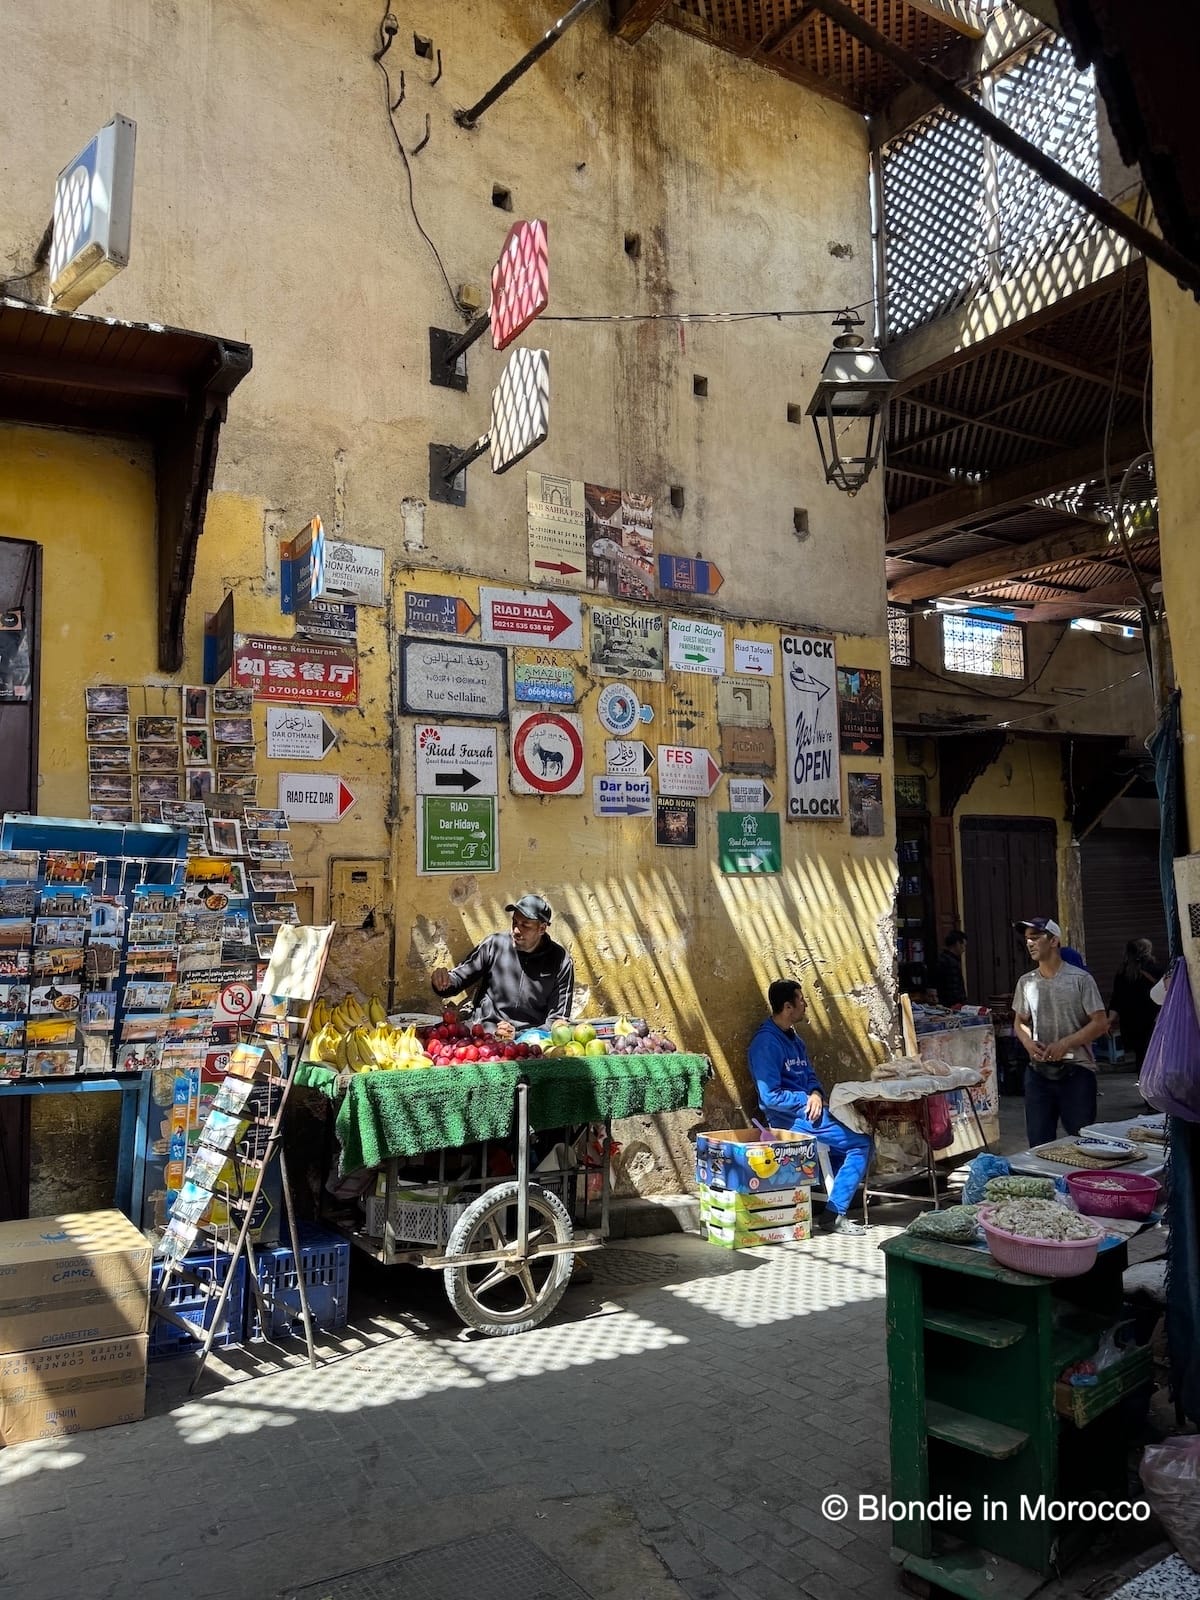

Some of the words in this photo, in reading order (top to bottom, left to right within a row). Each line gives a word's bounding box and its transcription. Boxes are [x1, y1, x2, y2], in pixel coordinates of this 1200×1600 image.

[545, 504, 569, 517] SAHRA
[570, 510, 585, 519] FES
[331, 572, 352, 581] HOSTEL
[345, 564, 380, 577] KAWTAR
[408, 594, 430, 608] Dar
[409, 608, 439, 622] Iman
[494, 604, 520, 616] RIAD
[524, 608, 554, 619] HALA
[494, 620, 514, 628] 00212
[594, 612, 620, 627] Riad
[671, 622, 692, 633] Riad
[694, 625, 722, 638] Ridaya
[679, 643, 704, 652] PANORAMIC
[704, 646, 716, 654] VIEW
[698, 638, 712, 646] HOUSE
[735, 644, 748, 652] Riad
[784, 637, 833, 659] CLOCK
[252, 642, 287, 652] Chinese
[290, 645, 338, 656] Restaurant
[467, 656, 489, 671] زنقة
[536, 656, 558, 666] DAR
[237, 657, 353, 684] 如家餐厅
[524, 679, 569, 690] GUESTHOUSE
[269, 686, 342, 698] 0700491766
[426, 689, 444, 700] Rue
[447, 690, 487, 704] Sellaline
[288, 732, 320, 740] OTHMANE
[816, 731, 832, 744] We're
[426, 743, 456, 757] Riad
[460, 744, 493, 758] Farah
[666, 750, 693, 764] FES
[426, 758, 440, 766] Guest
[794, 749, 832, 785] OPEN
[600, 780, 622, 792] Dar
[626, 780, 649, 794] borj
[731, 786, 740, 794] RIAD
[286, 791, 304, 803] RIAD
[305, 791, 318, 804] FEZ
[319, 792, 334, 804] DAR
[600, 795, 624, 803] Guest
[626, 795, 650, 803] house
[658, 798, 674, 806] RIAD
[675, 799, 696, 808] NOHA
[450, 802, 469, 812] RIAD
[790, 797, 840, 816] CLOCK
[440, 819, 452, 830] Dar
[454, 819, 480, 832] Hidaya
[728, 838, 741, 847] Riad
[229, 992, 244, 1006] 18
[218, 1056, 227, 1065] 18
[768, 1232, 786, 1241] Maroc
[52, 1268, 96, 1282] CAMEL
[42, 1328, 99, 1343] CIGARETTES
[91, 1343, 130, 1355] FILTER
[7, 1351, 83, 1368] CIGARETTES
[93, 1352, 132, 1362] ROUND
[36, 1358, 84, 1371] CORNER
[4, 1366, 28, 1377] BOX
[46, 1408, 77, 1421] Winston
